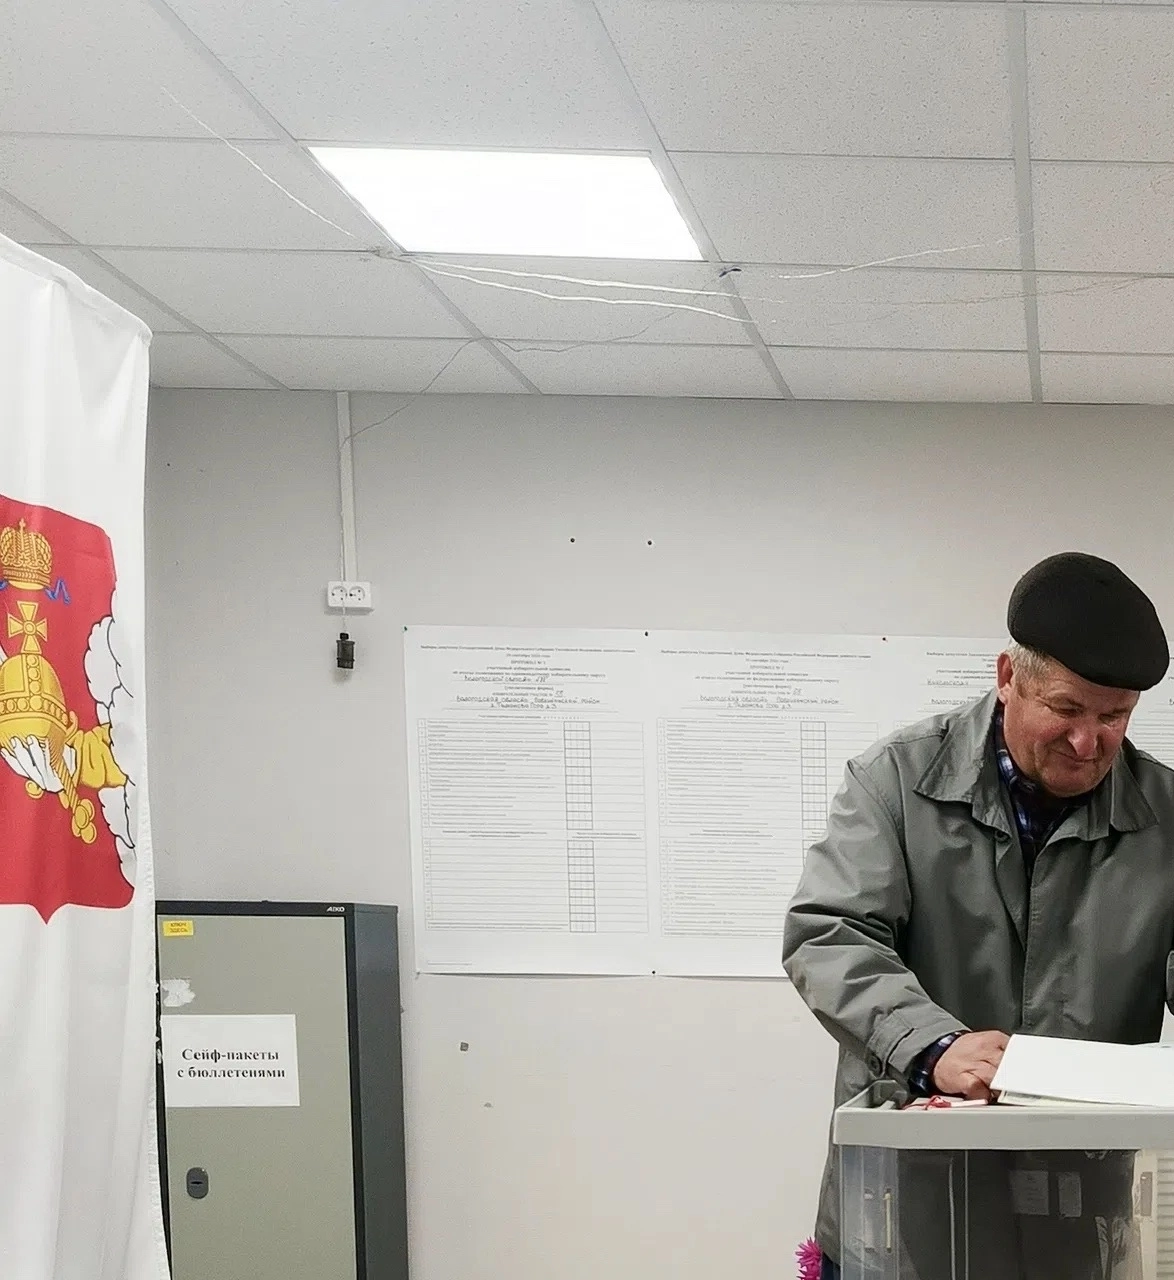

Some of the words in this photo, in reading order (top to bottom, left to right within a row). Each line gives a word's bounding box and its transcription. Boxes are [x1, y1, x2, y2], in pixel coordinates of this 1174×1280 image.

[182, 1049, 279, 1063] Сейф-пакеты
[177, 1070, 184, 1078] с
[188, 1066, 285, 1078] бюллетенями
